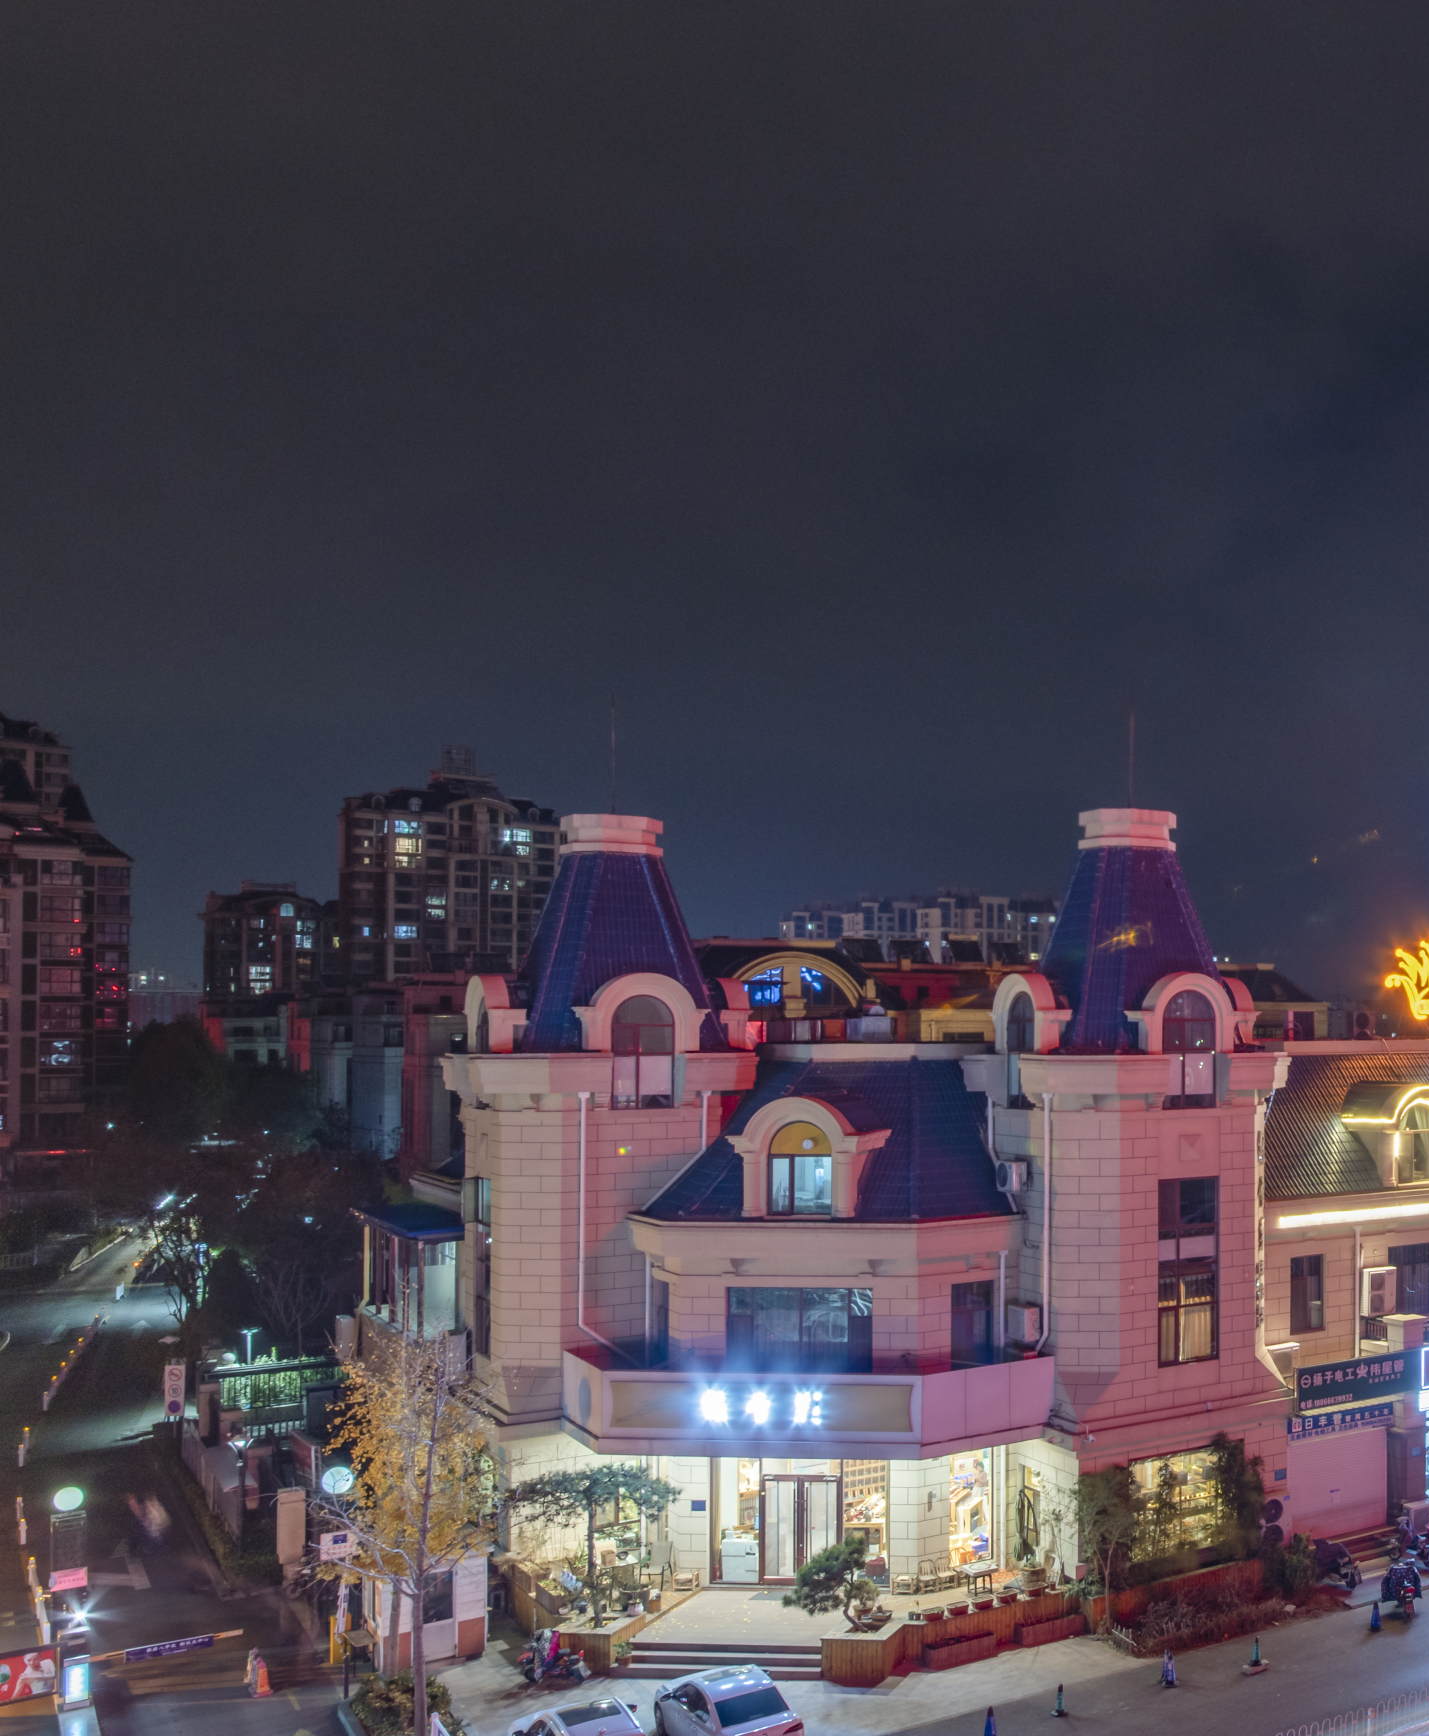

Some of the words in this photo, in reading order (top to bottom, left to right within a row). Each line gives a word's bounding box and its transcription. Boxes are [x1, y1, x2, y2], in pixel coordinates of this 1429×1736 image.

[1312, 1367, 1355, 1387] 扬子电工
[1369, 1359, 1405, 1376] 伟星管
[1304, 1412, 1342, 1429] 日丰管
